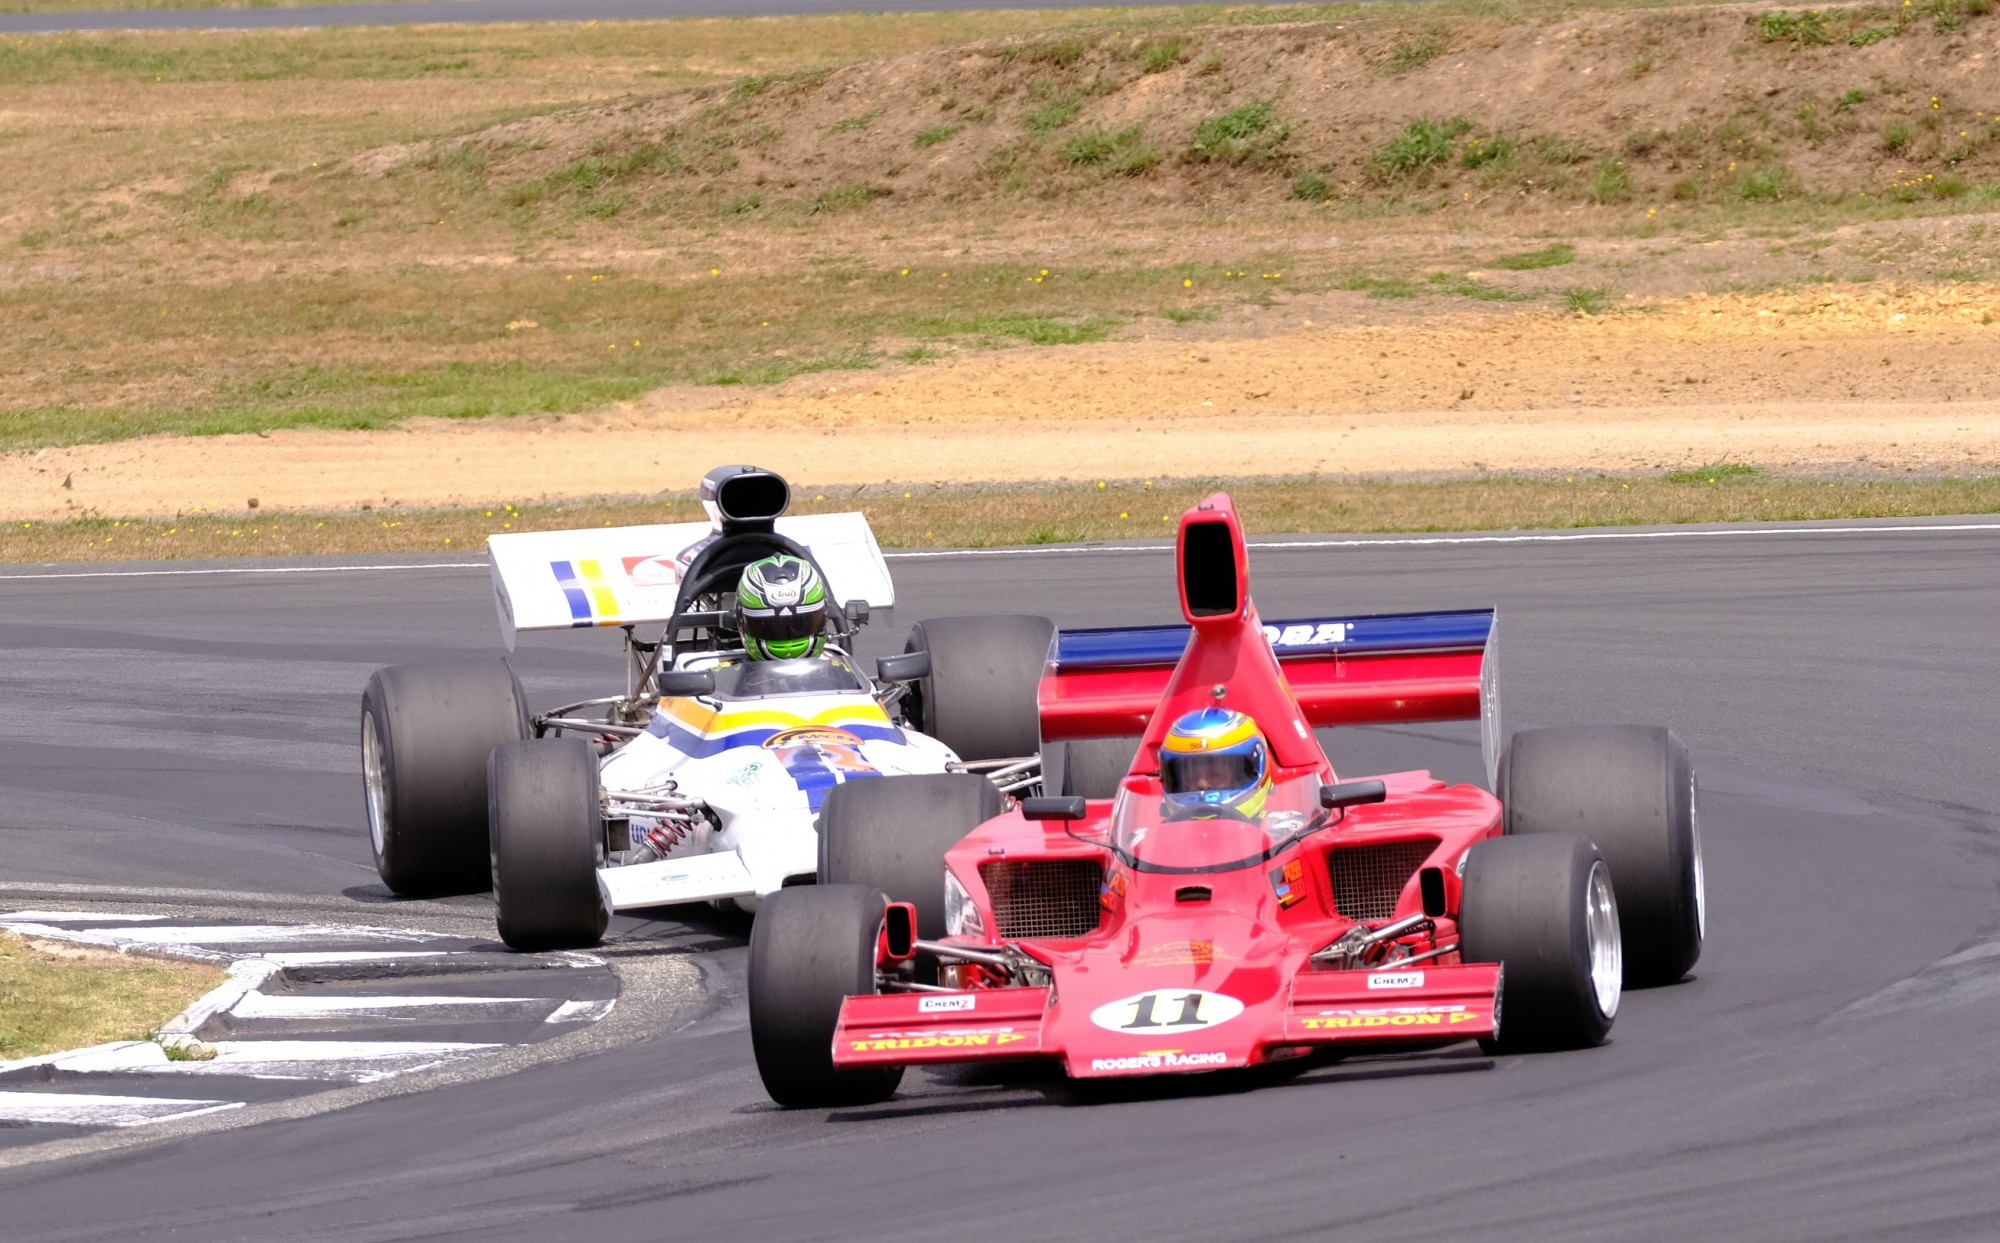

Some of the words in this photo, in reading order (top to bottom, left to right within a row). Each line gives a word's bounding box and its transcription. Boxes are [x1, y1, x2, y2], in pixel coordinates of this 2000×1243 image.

[1120, 993, 1209, 1029] 11
[1302, 1013, 1443, 1029] TRIDON
[851, 1034, 990, 1051] TRIDON
[1165, 1052, 1228, 1067] RACING
